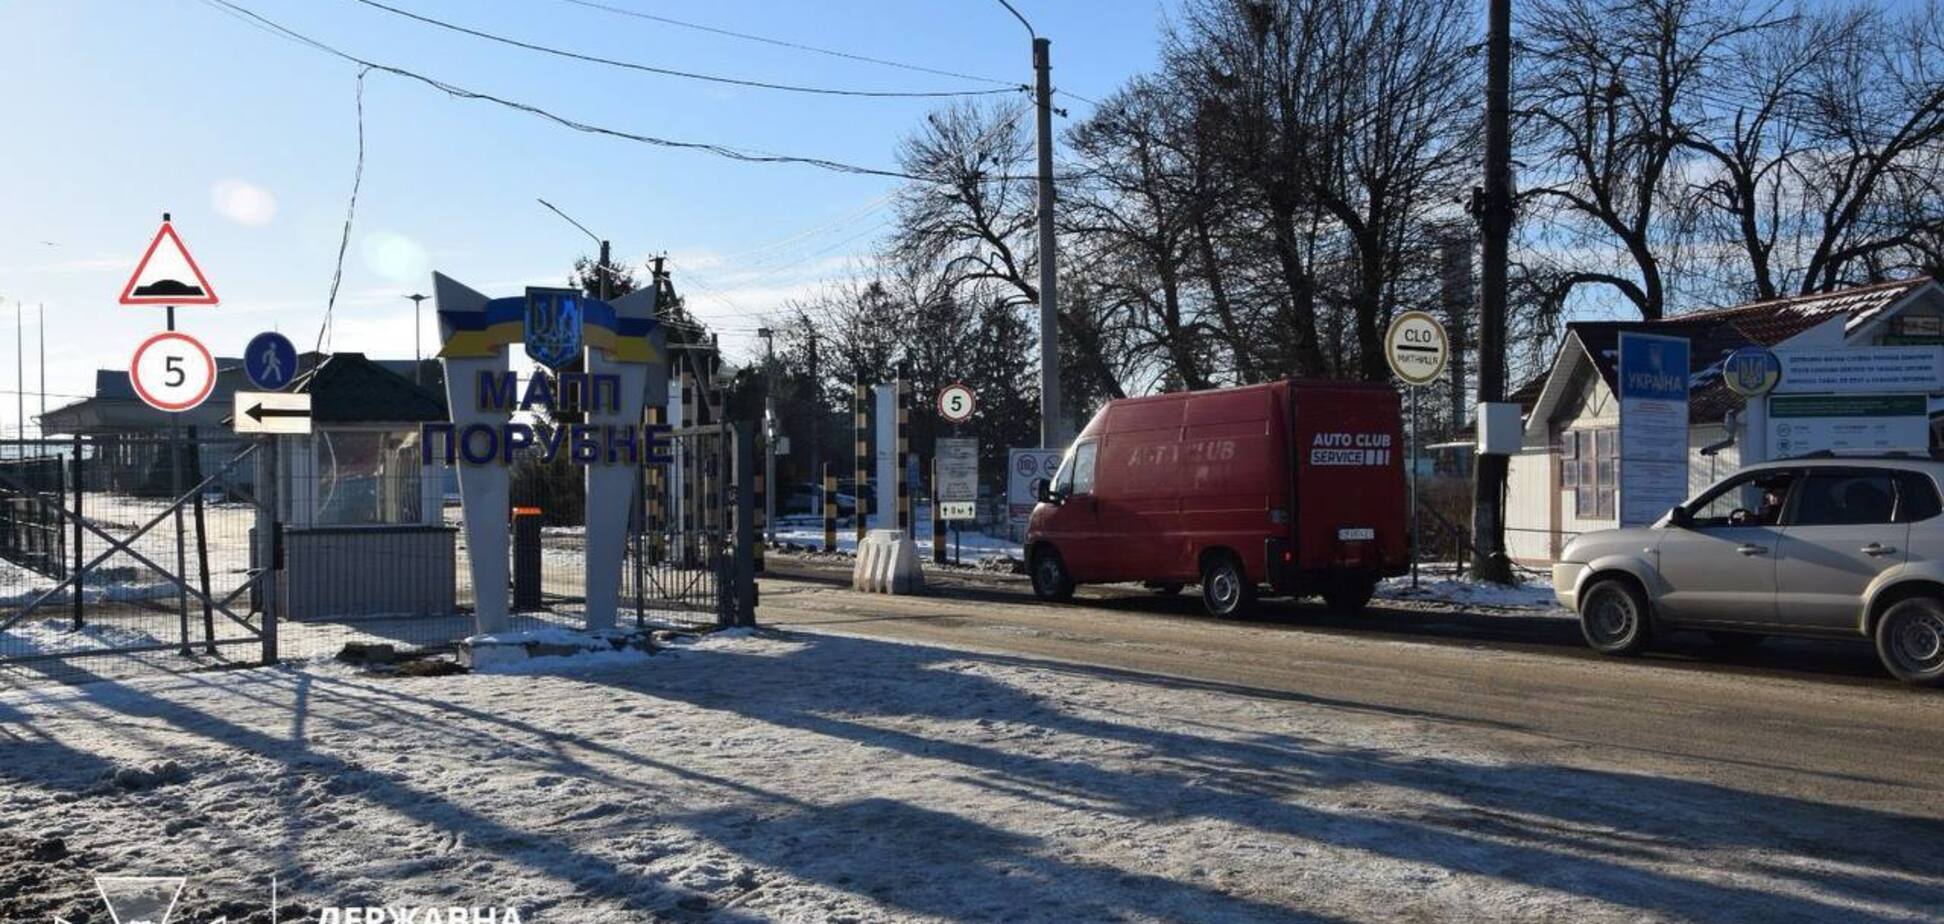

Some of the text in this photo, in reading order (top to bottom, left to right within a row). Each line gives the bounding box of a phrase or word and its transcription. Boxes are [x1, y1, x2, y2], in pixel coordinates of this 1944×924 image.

[1404, 328, 1432, 343] CLO
[164, 356, 186, 388] 5
[1628, 371, 1682, 393] УКРАЇНА
[478, 369, 622, 413] МАПП
[950, 396, 962, 412] 5
[421, 421, 674, 467] ПОРУБНЕ
[1313, 433, 1392, 448] AUTO CLUB
[1127, 446, 1179, 467] AT
[1312, 450, 1363, 464] SERVICE
